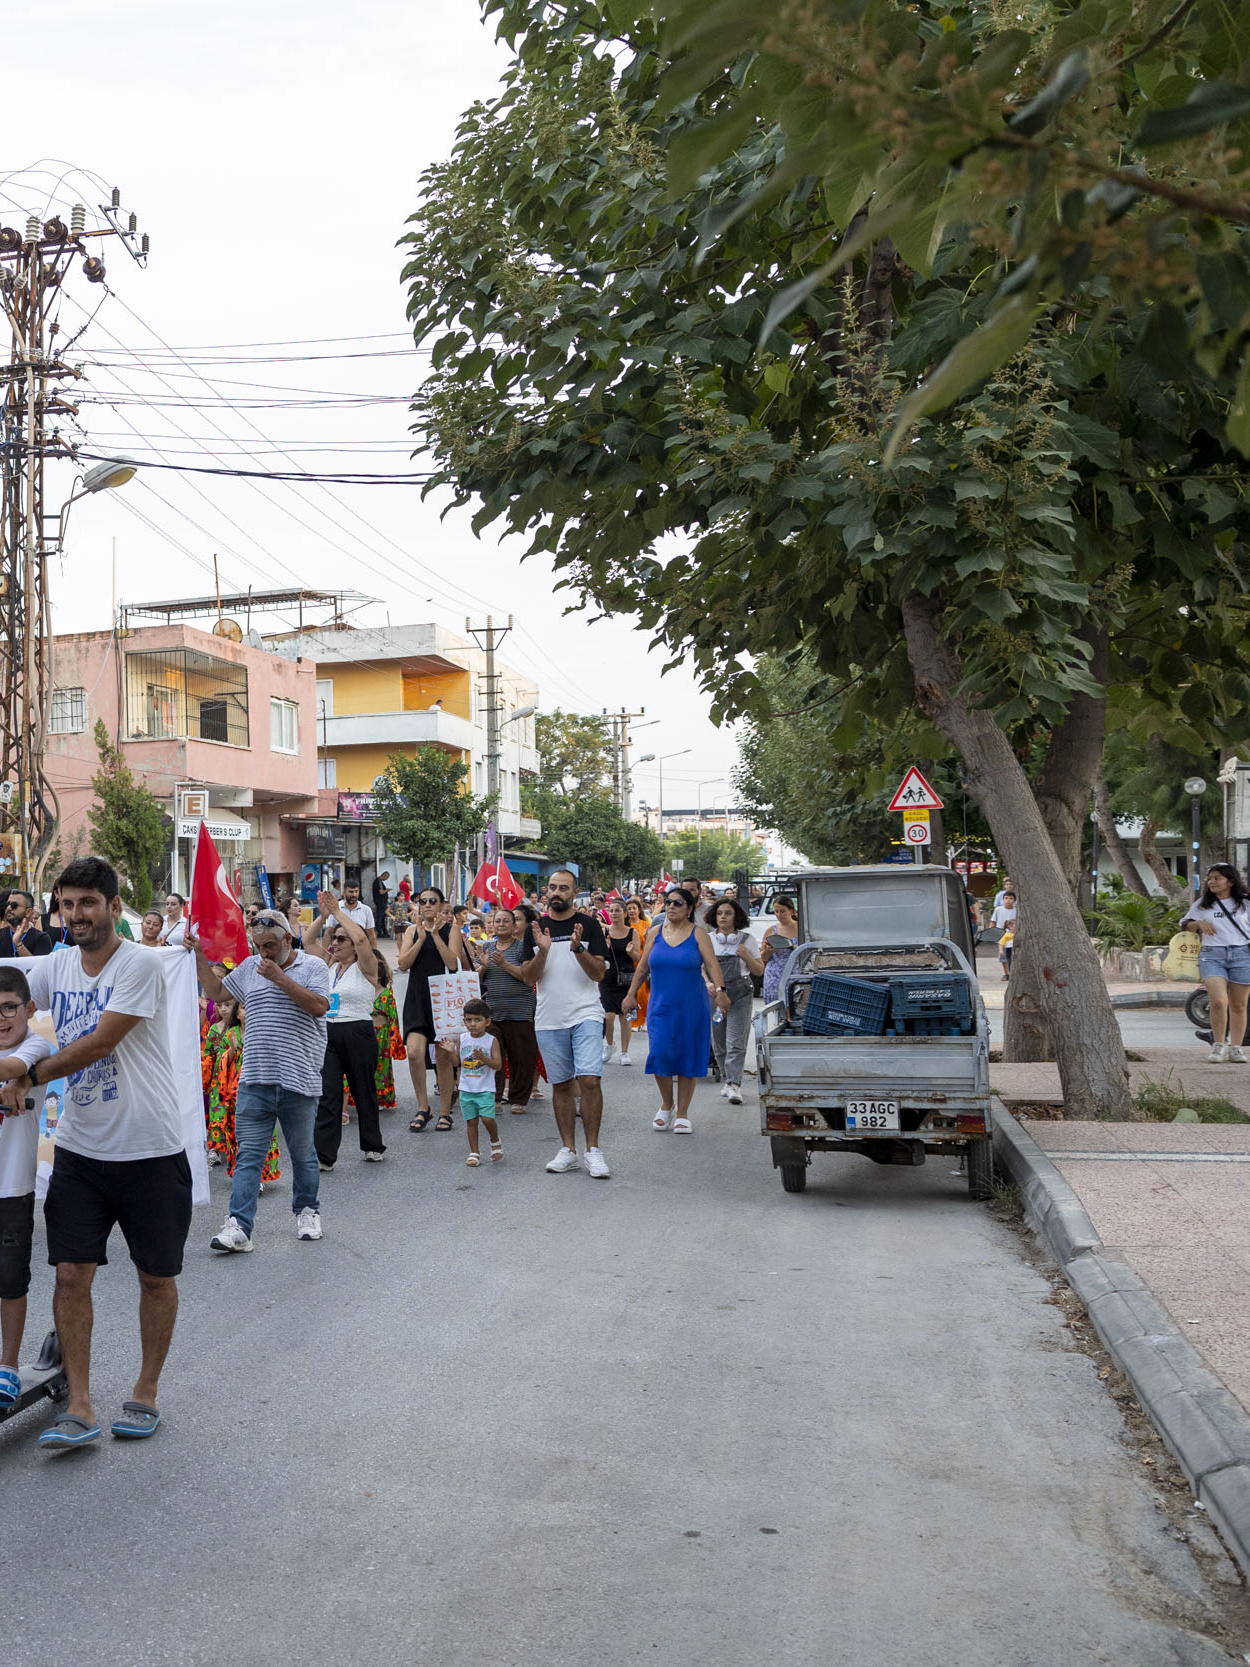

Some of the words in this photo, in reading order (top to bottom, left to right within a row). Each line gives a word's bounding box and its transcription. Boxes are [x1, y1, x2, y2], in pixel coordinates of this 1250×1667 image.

[188, 797, 201, 814] E
[911, 829, 924, 838] 30
[447, 997, 464, 1008] FLO
[850, 1102, 867, 1114] 33
[869, 1103, 896, 1115] AGC
[861, 1116, 887, 1128] 982
